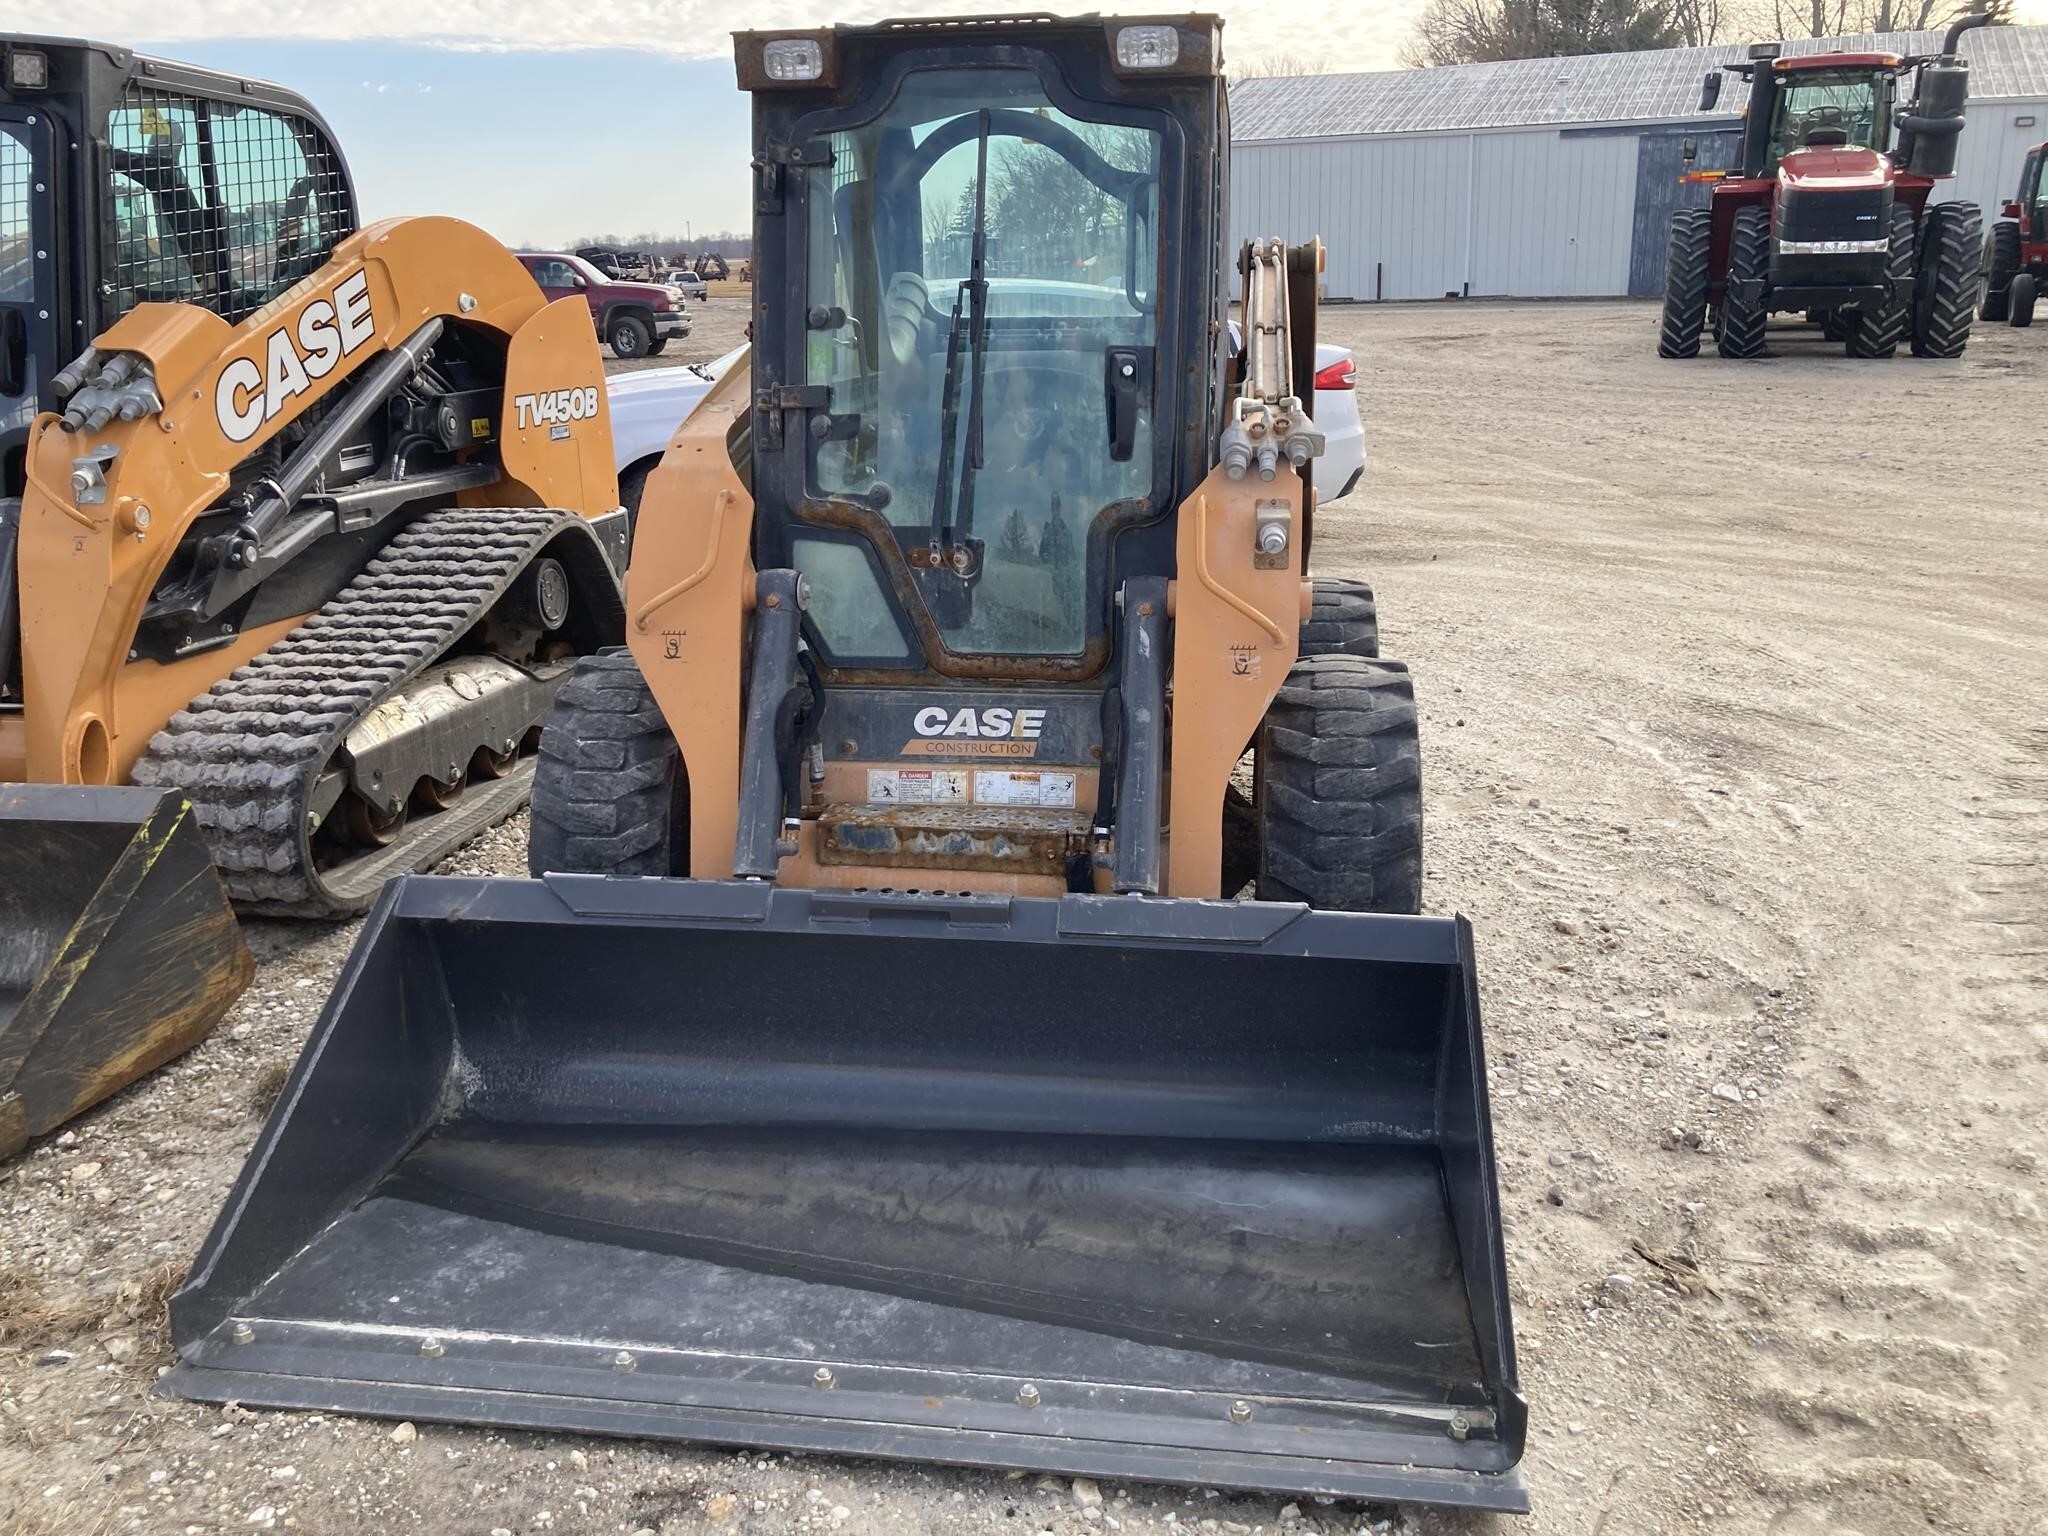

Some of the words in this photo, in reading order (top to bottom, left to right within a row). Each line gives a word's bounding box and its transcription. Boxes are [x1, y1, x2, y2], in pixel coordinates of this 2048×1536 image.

[215, 267, 375, 443] CASE
[514, 386, 599, 430] TV450B
[913, 706, 1047, 738] CASE
[925, 742, 1031, 755] CONSTRUCTION
